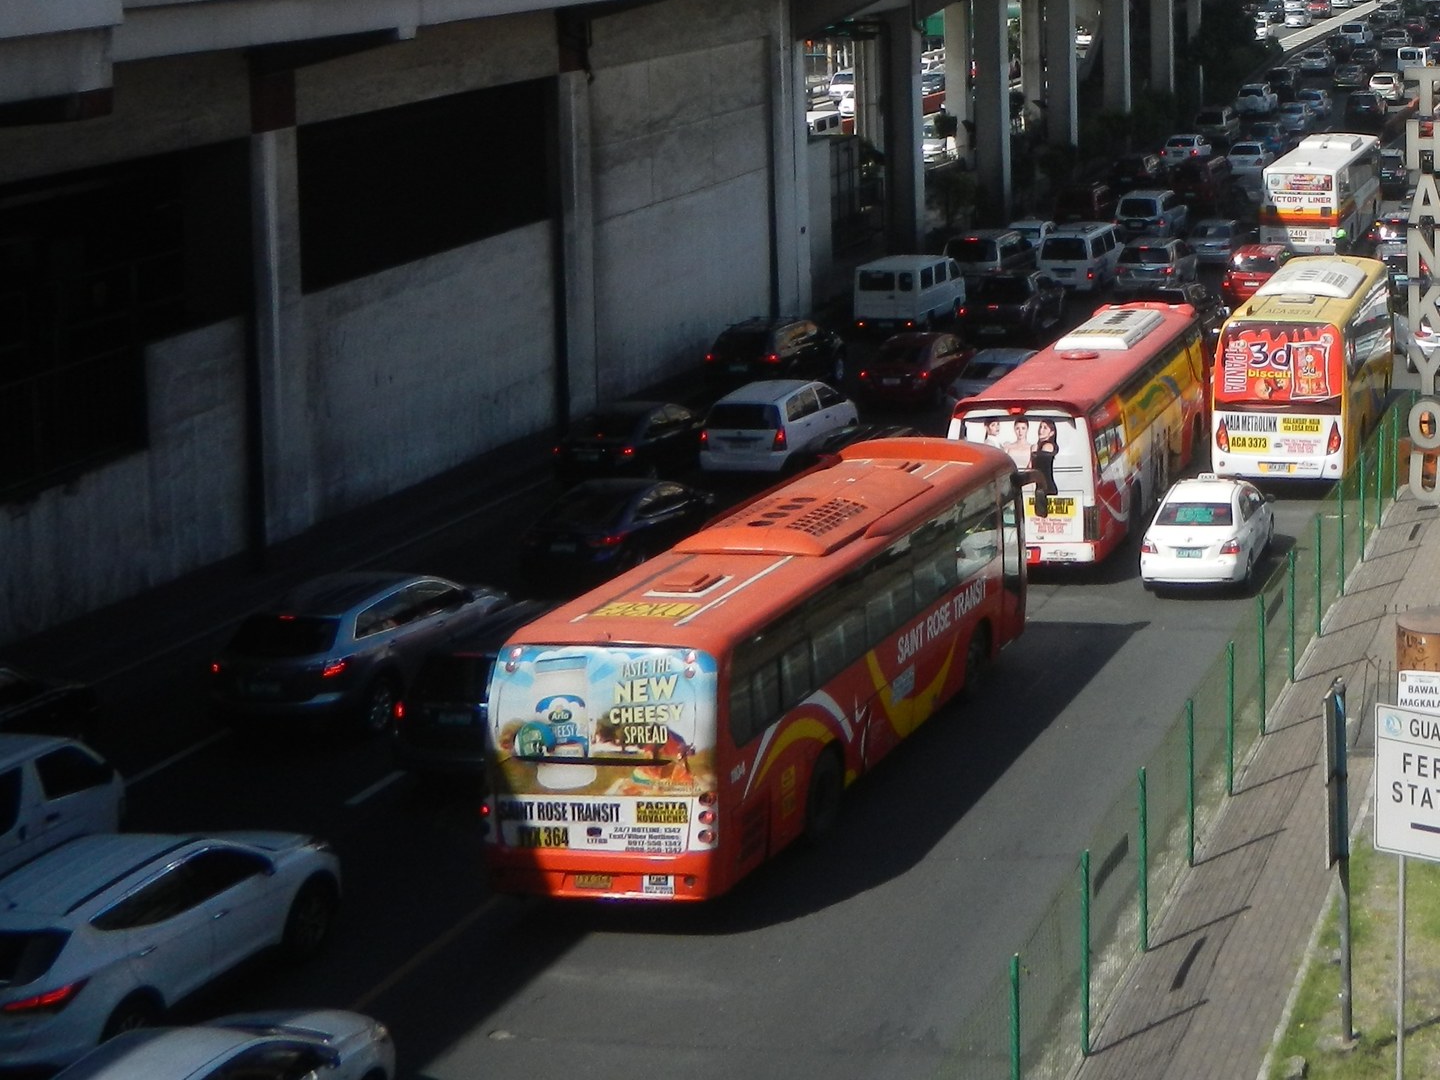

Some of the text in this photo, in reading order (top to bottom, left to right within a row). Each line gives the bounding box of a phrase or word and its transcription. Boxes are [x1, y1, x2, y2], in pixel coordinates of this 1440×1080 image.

[1268, 195, 1332, 204] VICTORY LINER
[1289, 229, 1308, 237] 2404
[1248, 340, 1292, 370] 3d
[1225, 414, 1278, 432] NAIA METROLINK
[1231, 437, 1247, 448] ACA
[1248, 437, 1268, 449] 3373
[897, 577, 987, 664] SAINT ROSE TRANSIT
[621, 655, 672, 679] TASTE THE
[614, 675, 679, 704] NEW
[1408, 685, 1439, 695] BAWAL
[608, 704, 686, 724] CHEESY
[623, 725, 669, 744] SPREAD
[538, 802, 567, 822] ROSE
[570, 803, 621, 823] TRANSIT
[637, 801, 688, 810] PACITA
[544, 827, 569, 847] 364
